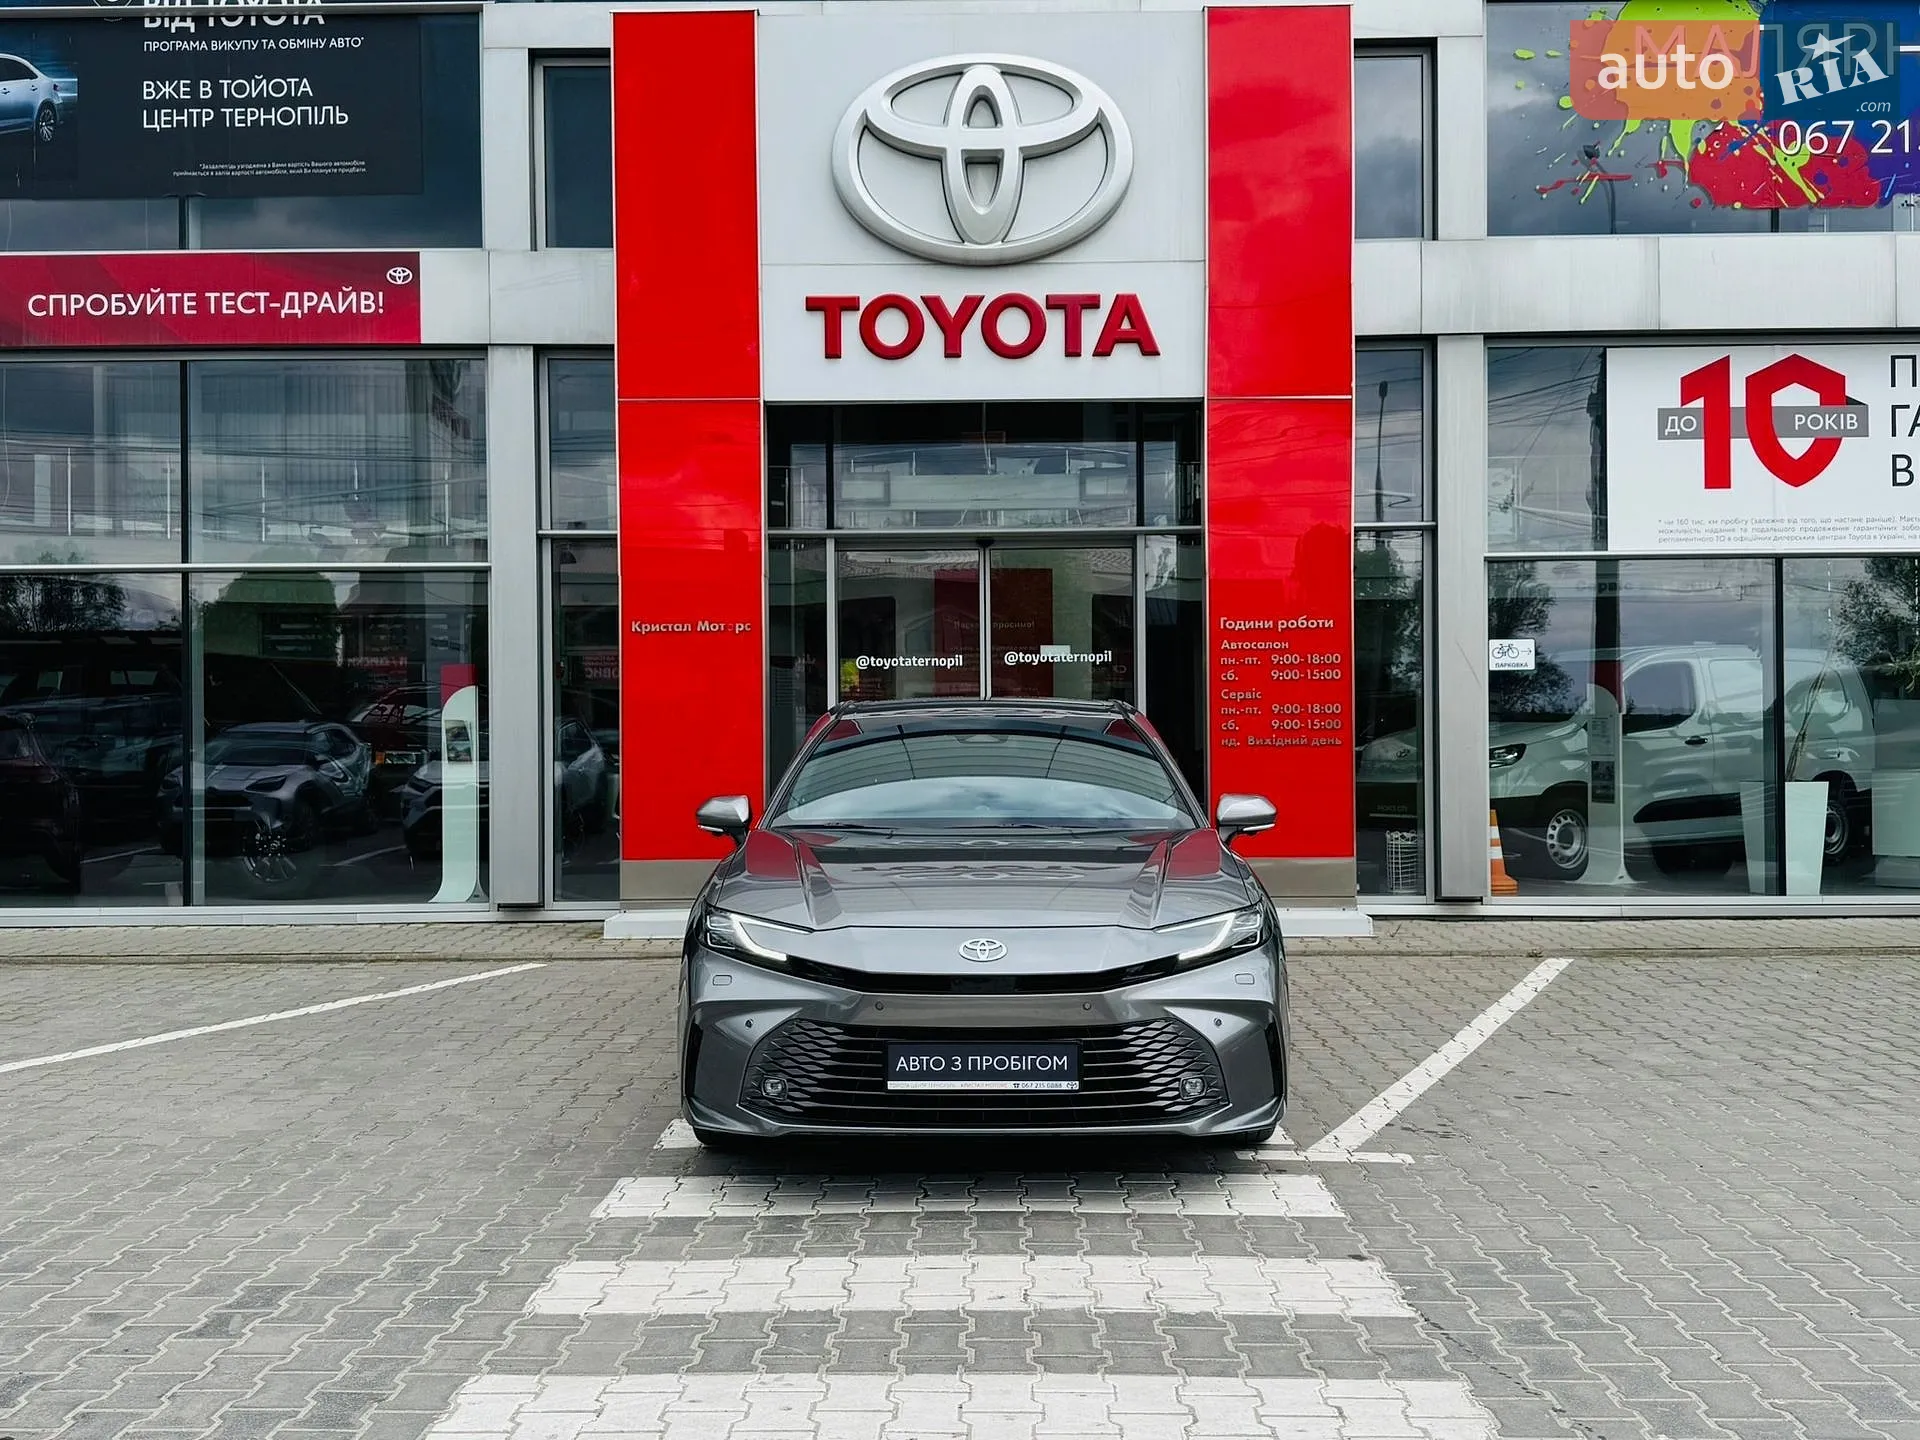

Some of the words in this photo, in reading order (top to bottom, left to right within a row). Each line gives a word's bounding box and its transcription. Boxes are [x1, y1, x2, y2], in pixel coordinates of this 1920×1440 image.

[144, 40, 208, 52] ПРОГРАМА
[211, 39, 258, 51] ВИКУПУ
[260, 39, 276, 50] ТА
[278, 38, 327, 50] ОБМІНУ
[143, 80, 191, 100] ВЖЕ
[200, 80, 212, 99] В
[219, 75, 313, 99] ТОЙОТА
[143, 107, 214, 132] ЦЕНТР
[221, 105, 348, 128] ТЕРНОПІЛЬ
[1778, 119, 1854, 155] 067
[1870, 119, 1920, 154] 21
[28, 287, 198, 317] СПРОБУЙТЕ
[204, 285, 384, 318] ТЕСТ-ДРАЙВ!
[805, 292, 1161, 360] TOYOTA
[1664, 415, 1697, 436] ДО
[1680, 353, 1846, 489] 10
[1794, 413, 1858, 431] РОКІВ
[1677, 518, 1689, 526] 160
[631, 620, 692, 635] Кристал
[1220, 616, 1273, 631] Години
[1278, 615, 1334, 632] роботи
[1221, 639, 1289, 650] Автосалон
[855, 654, 963, 670] @toyotaternopil
[1004, 651, 1112, 666] @toyotaternopil
[1220, 656, 1261, 665] пн.-пт.
[1221, 669, 1239, 681] сб.
[1221, 688, 1262, 703] Сервіс
[1221, 706, 1261, 715] пн.-пт.
[1221, 719, 1239, 731] сб.
[1221, 738, 1240, 747] нд.
[1247, 734, 1308, 747] Вихідний
[1311, 738, 1342, 747] день
[895, 1056, 945, 1071] АВТО
[968, 1055, 1068, 1071] ПРОБІГОМ
